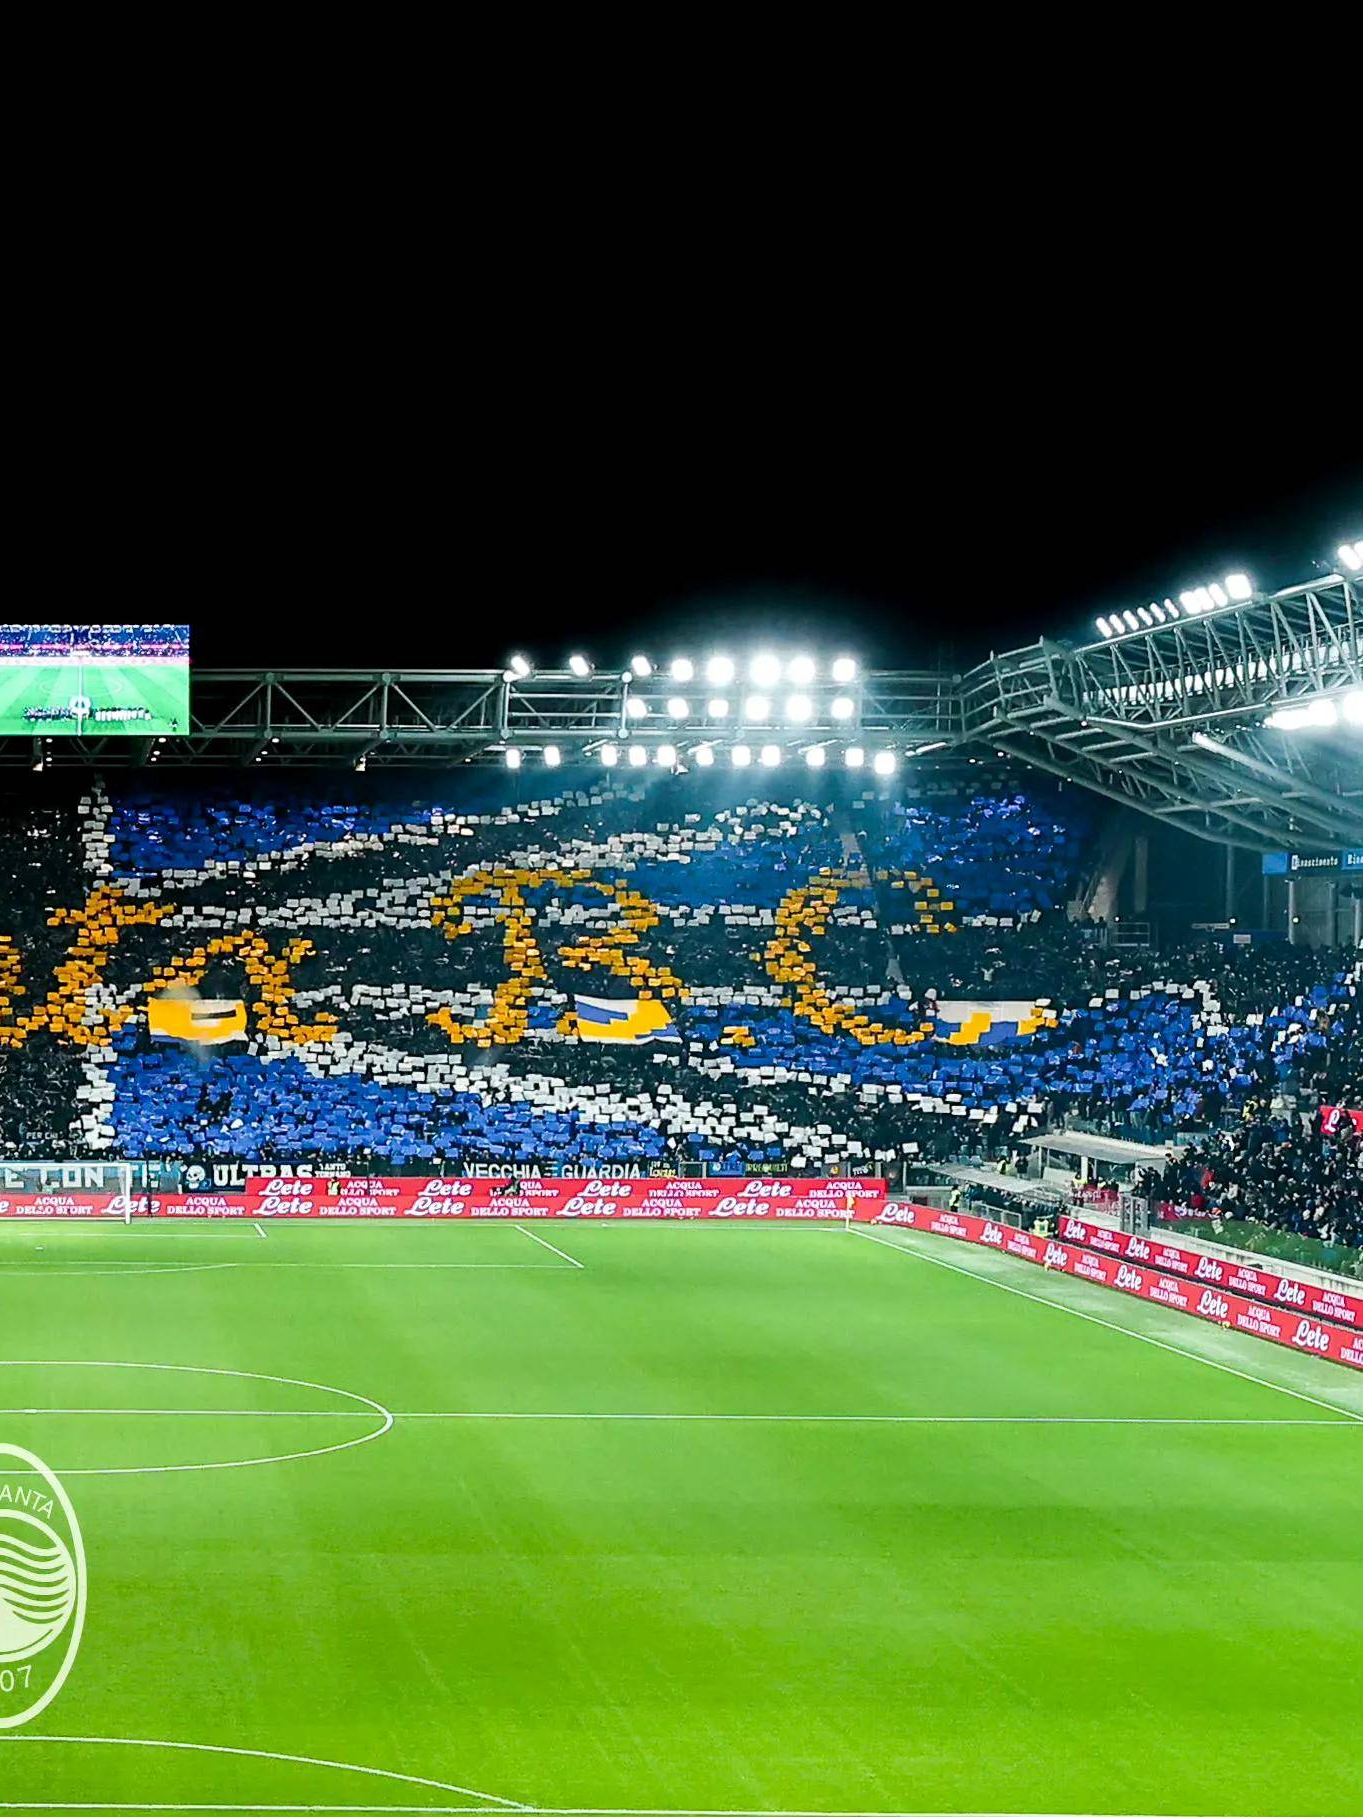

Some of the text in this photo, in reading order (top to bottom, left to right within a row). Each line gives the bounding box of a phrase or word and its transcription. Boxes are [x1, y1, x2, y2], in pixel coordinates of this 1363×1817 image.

[213, 1163, 313, 1186] ULTRAS
[462, 1161, 542, 1178] VECCHIA
[561, 1163, 640, 1179] GUARDIA
[259, 1179, 313, 1196] Lete
[418, 1179, 472, 1196] Lete
[519, 1181, 543, 1190] QUA
[577, 1180, 632, 1197] Lete
[666, 1181, 703, 1190] ACQUA
[738, 1180, 792, 1197] Lete
[809, 1189, 880, 1198] DELLO SPORT
[826, 1181, 863, 1191] ACQUA
[34, 1196, 74, 1206] ACQUA
[56, 1205, 93, 1214] SPORT
[185, 1196, 226, 1207] ACQUA
[253, 1196, 314, 1216] Lete
[338, 1197, 378, 1208] ACQUA
[404, 1196, 465, 1216] Lete
[489, 1197, 530, 1208] ACQUA
[556, 1197, 617, 1217] Lete
[641, 1198, 683, 1209] ACQUA
[708, 1197, 770, 1217] Lete
[795, 1199, 836, 1210] ACQUA
[167, 1205, 245, 1215] DELLO SPORT
[319, 1206, 397, 1216] DELLO SPORT
[471, 1207, 549, 1216] DELLO SPORT
[623, 1207, 702, 1217] DELLO SPORT
[776, 1208, 815, 1217] DELLO
[876, 1203, 915, 1223] Lete
[980, 1222, 1003, 1244] Lete
[1064, 1219, 1086, 1241] Lete
[1043, 1242, 1068, 1267] Lete
[1125, 1237, 1150, 1260] Lete
[1194, 1256, 1223, 1281] Lete
[1114, 1264, 1142, 1291] Lete
[1274, 1279, 1306, 1305] Lete
[1322, 1292, 1345, 1307] ACQUA
[1197, 1289, 1229, 1318] Lete
[1312, 1300, 1356, 1322] DELLO SPORT
[1248, 1306, 1271, 1321] ACQUA
[1238, 1314, 1281, 1337] DELLO SPORT
[1292, 1320, 1329, 1351] Lete
